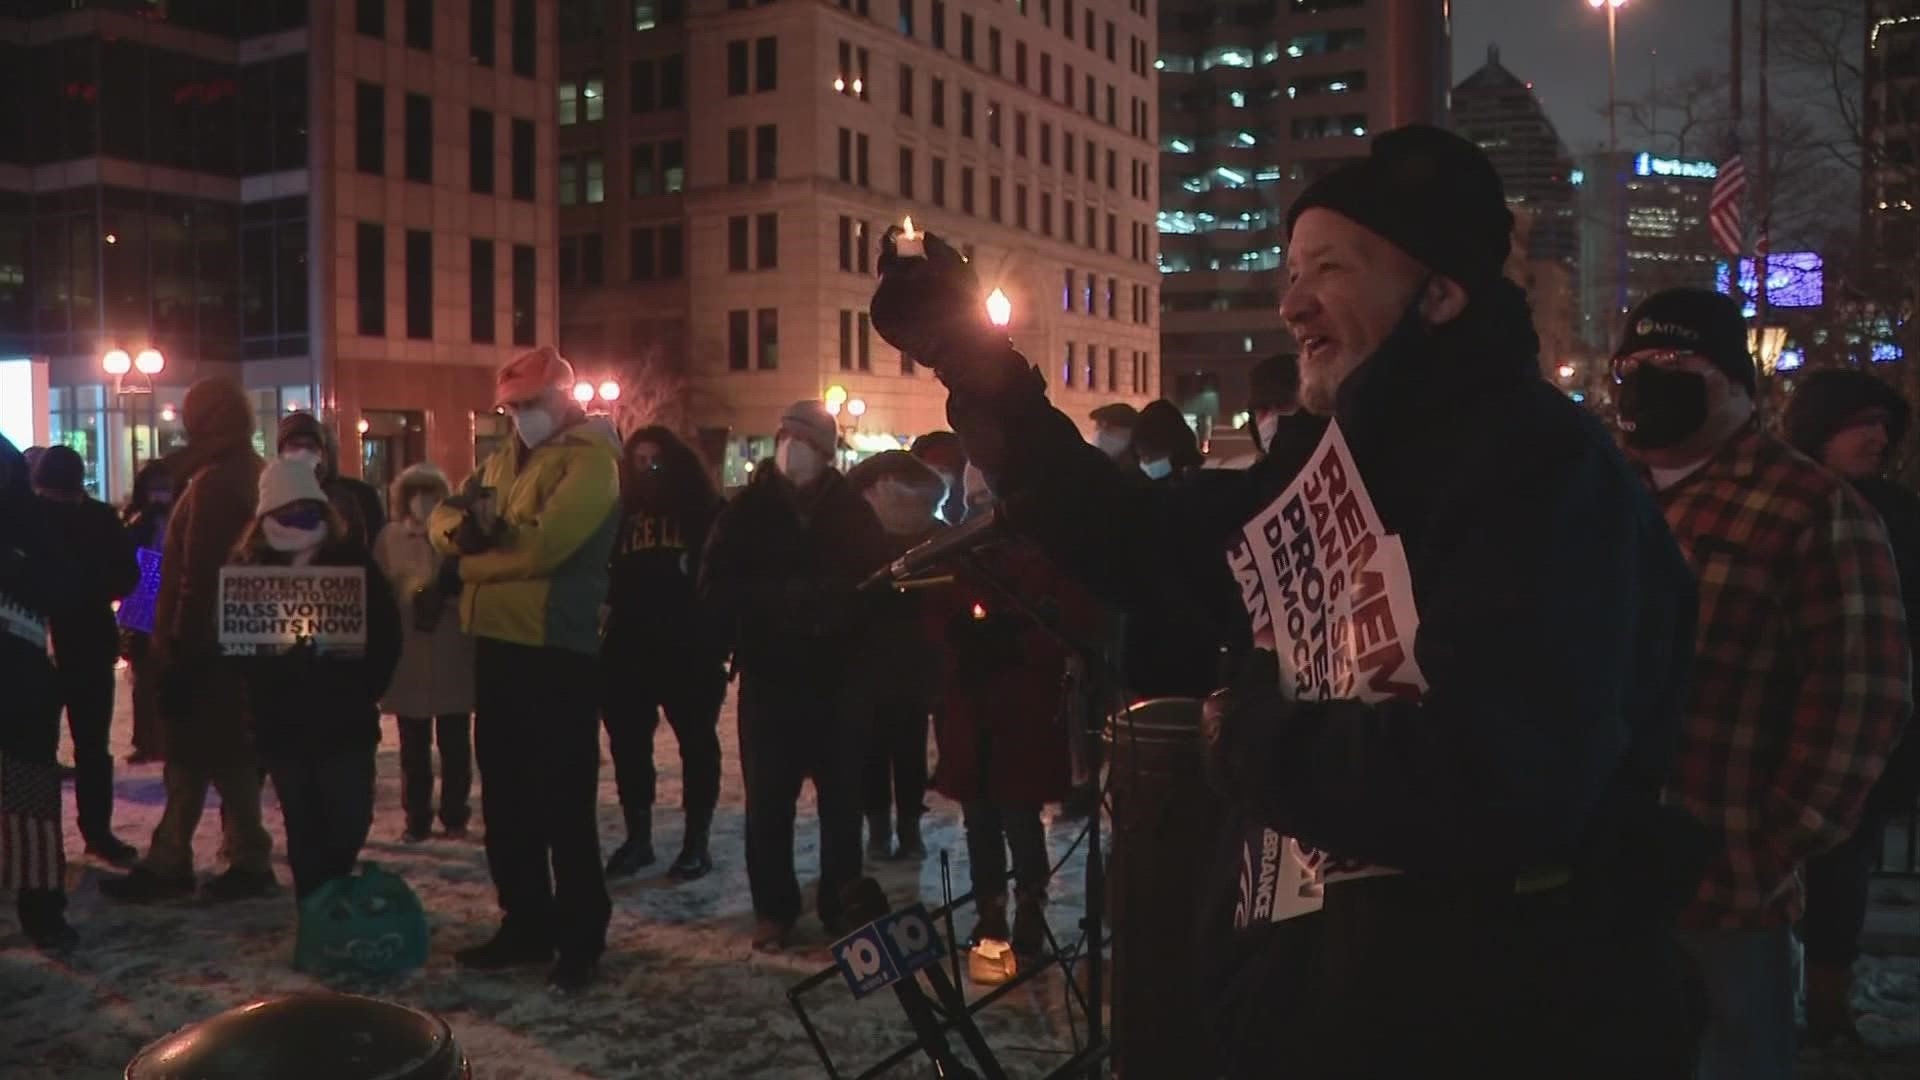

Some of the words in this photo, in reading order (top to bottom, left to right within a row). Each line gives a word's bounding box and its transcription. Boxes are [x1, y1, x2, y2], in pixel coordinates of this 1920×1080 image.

[1304, 471, 1342, 568] JAN
[224, 576, 314, 591] PROTECT
[319, 576, 362, 591] OUR
[223, 603, 278, 617] PASS
[282, 603, 362, 617] VOTING
[223, 619, 303, 634] RIGHTS
[308, 619, 362, 634] NOW
[887, 914, 929, 958] 10
[842, 937, 880, 982] 10
